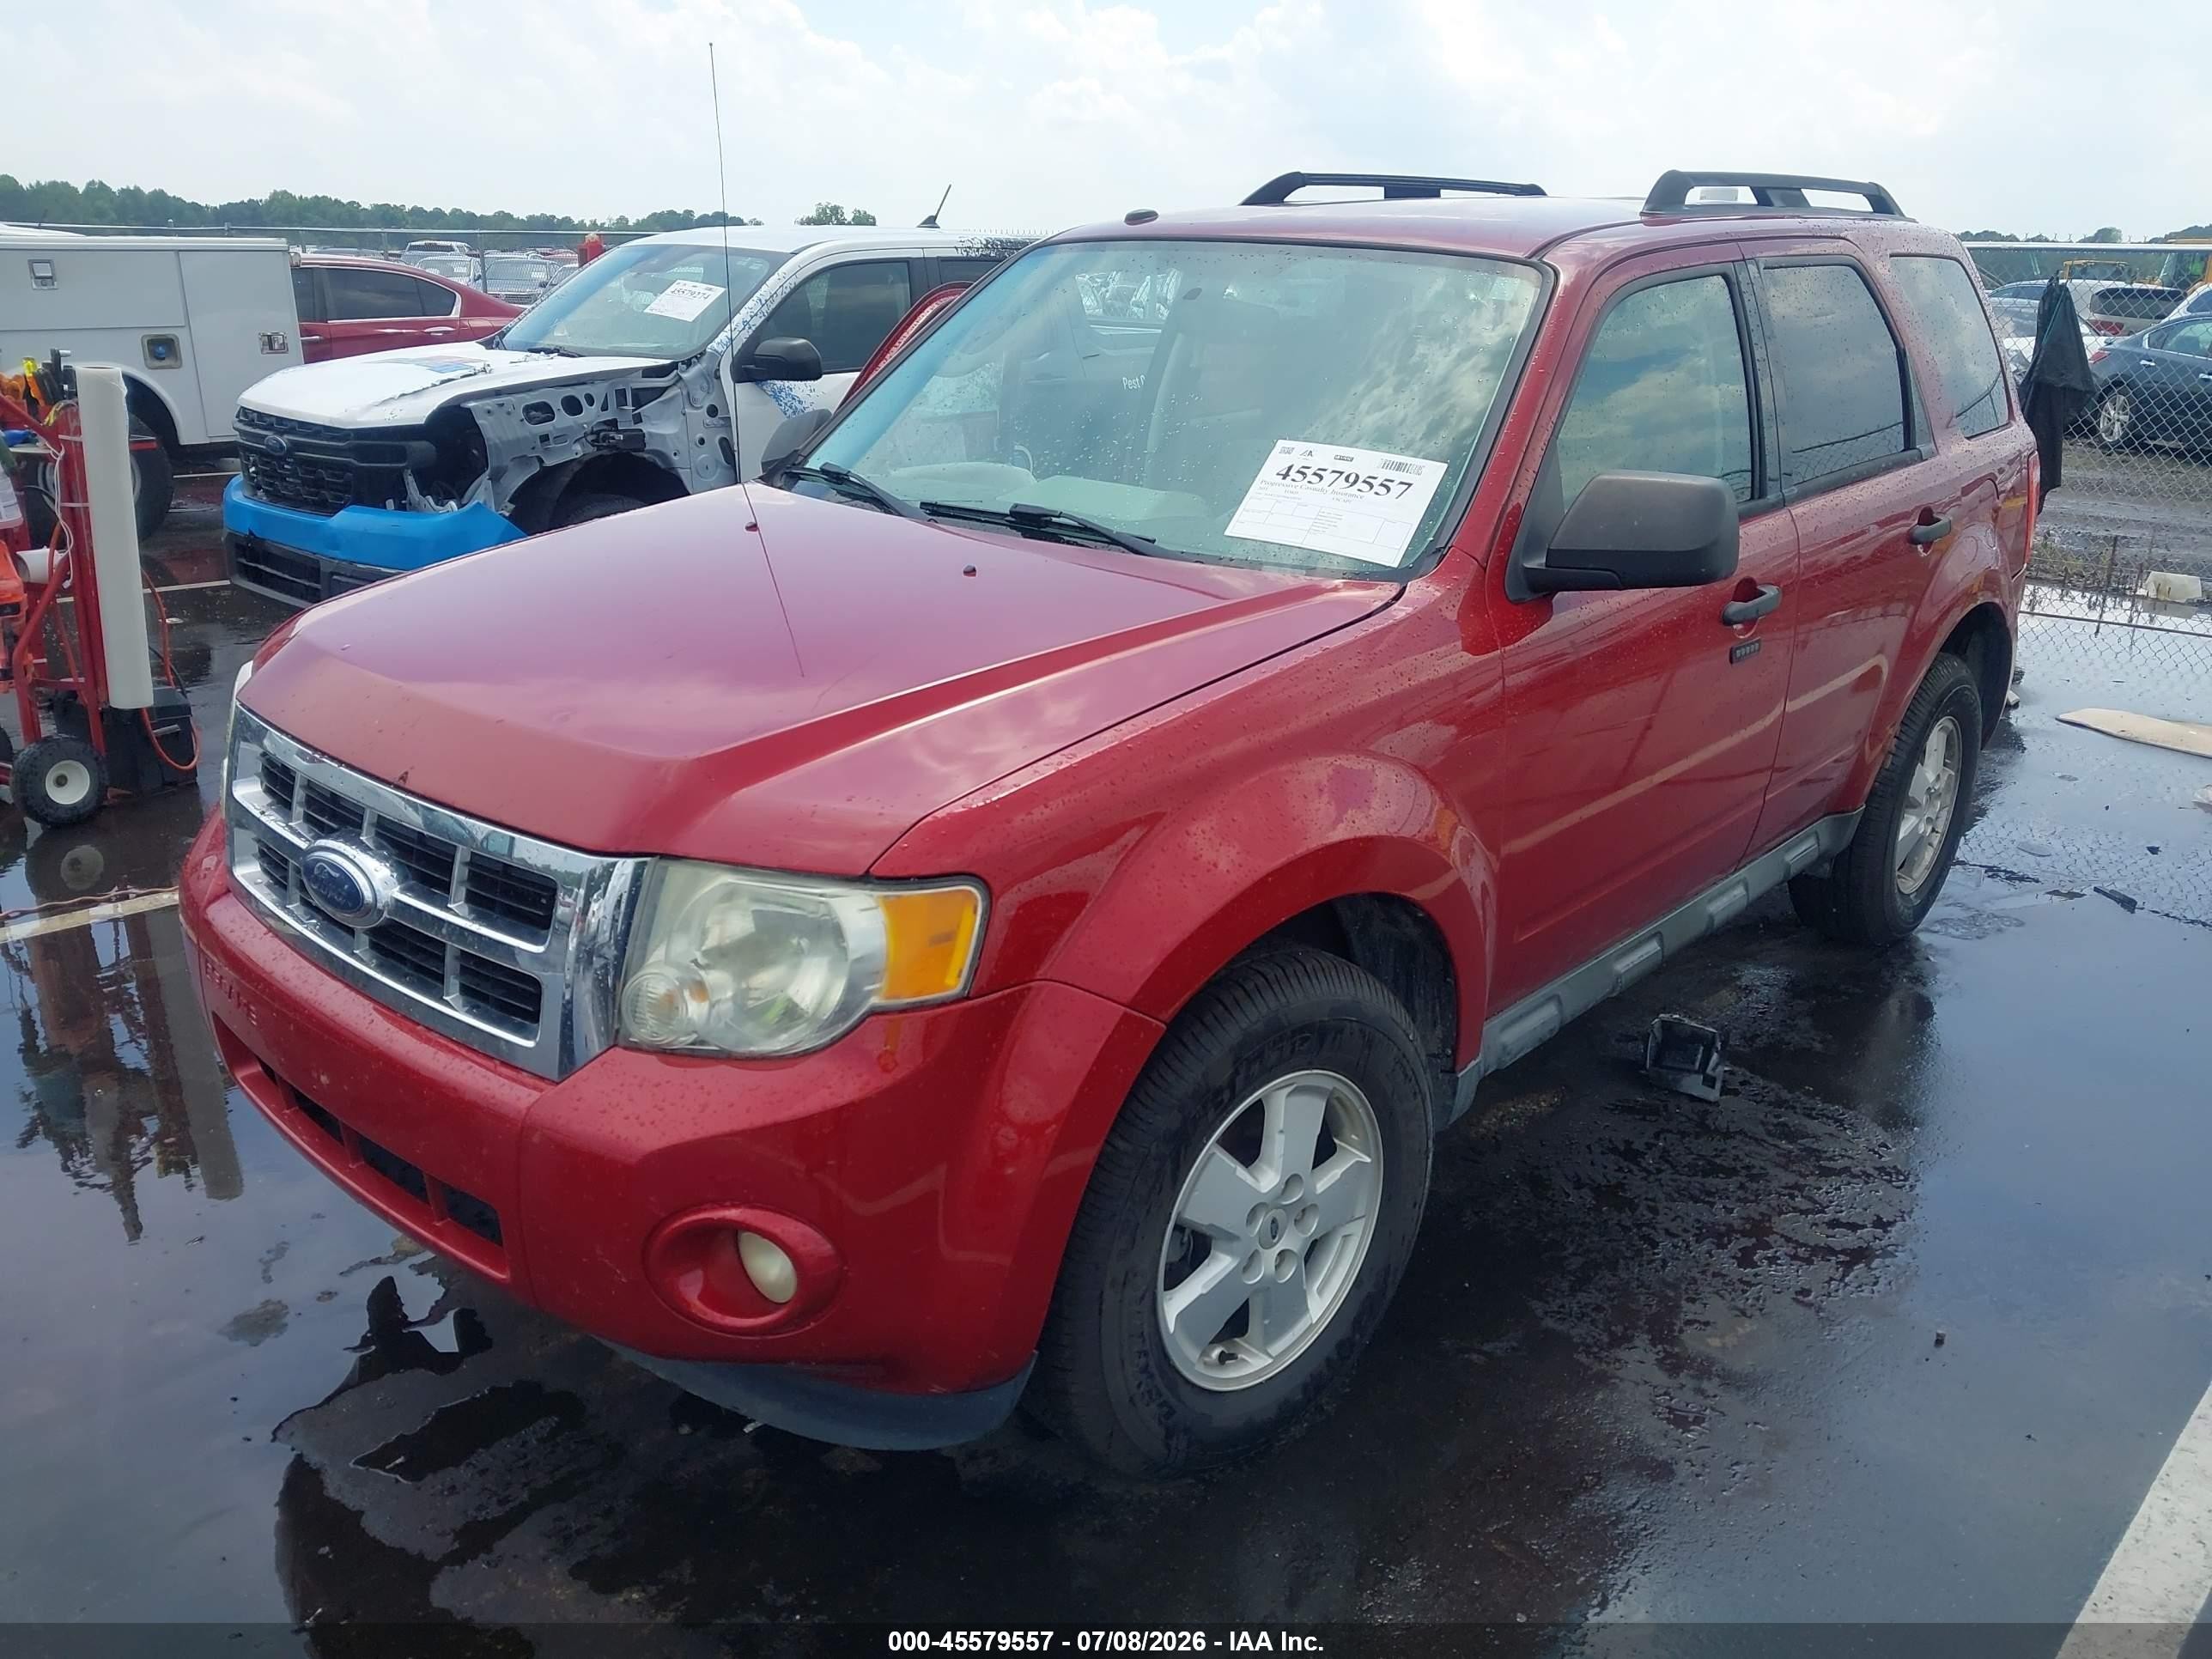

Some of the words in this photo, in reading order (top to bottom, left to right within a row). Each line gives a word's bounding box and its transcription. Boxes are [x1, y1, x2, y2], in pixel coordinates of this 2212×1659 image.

[1122, 377, 1140, 390] Pest
[1276, 464, 1414, 499] 45579557
[1331, 489, 1365, 500] Insurance
